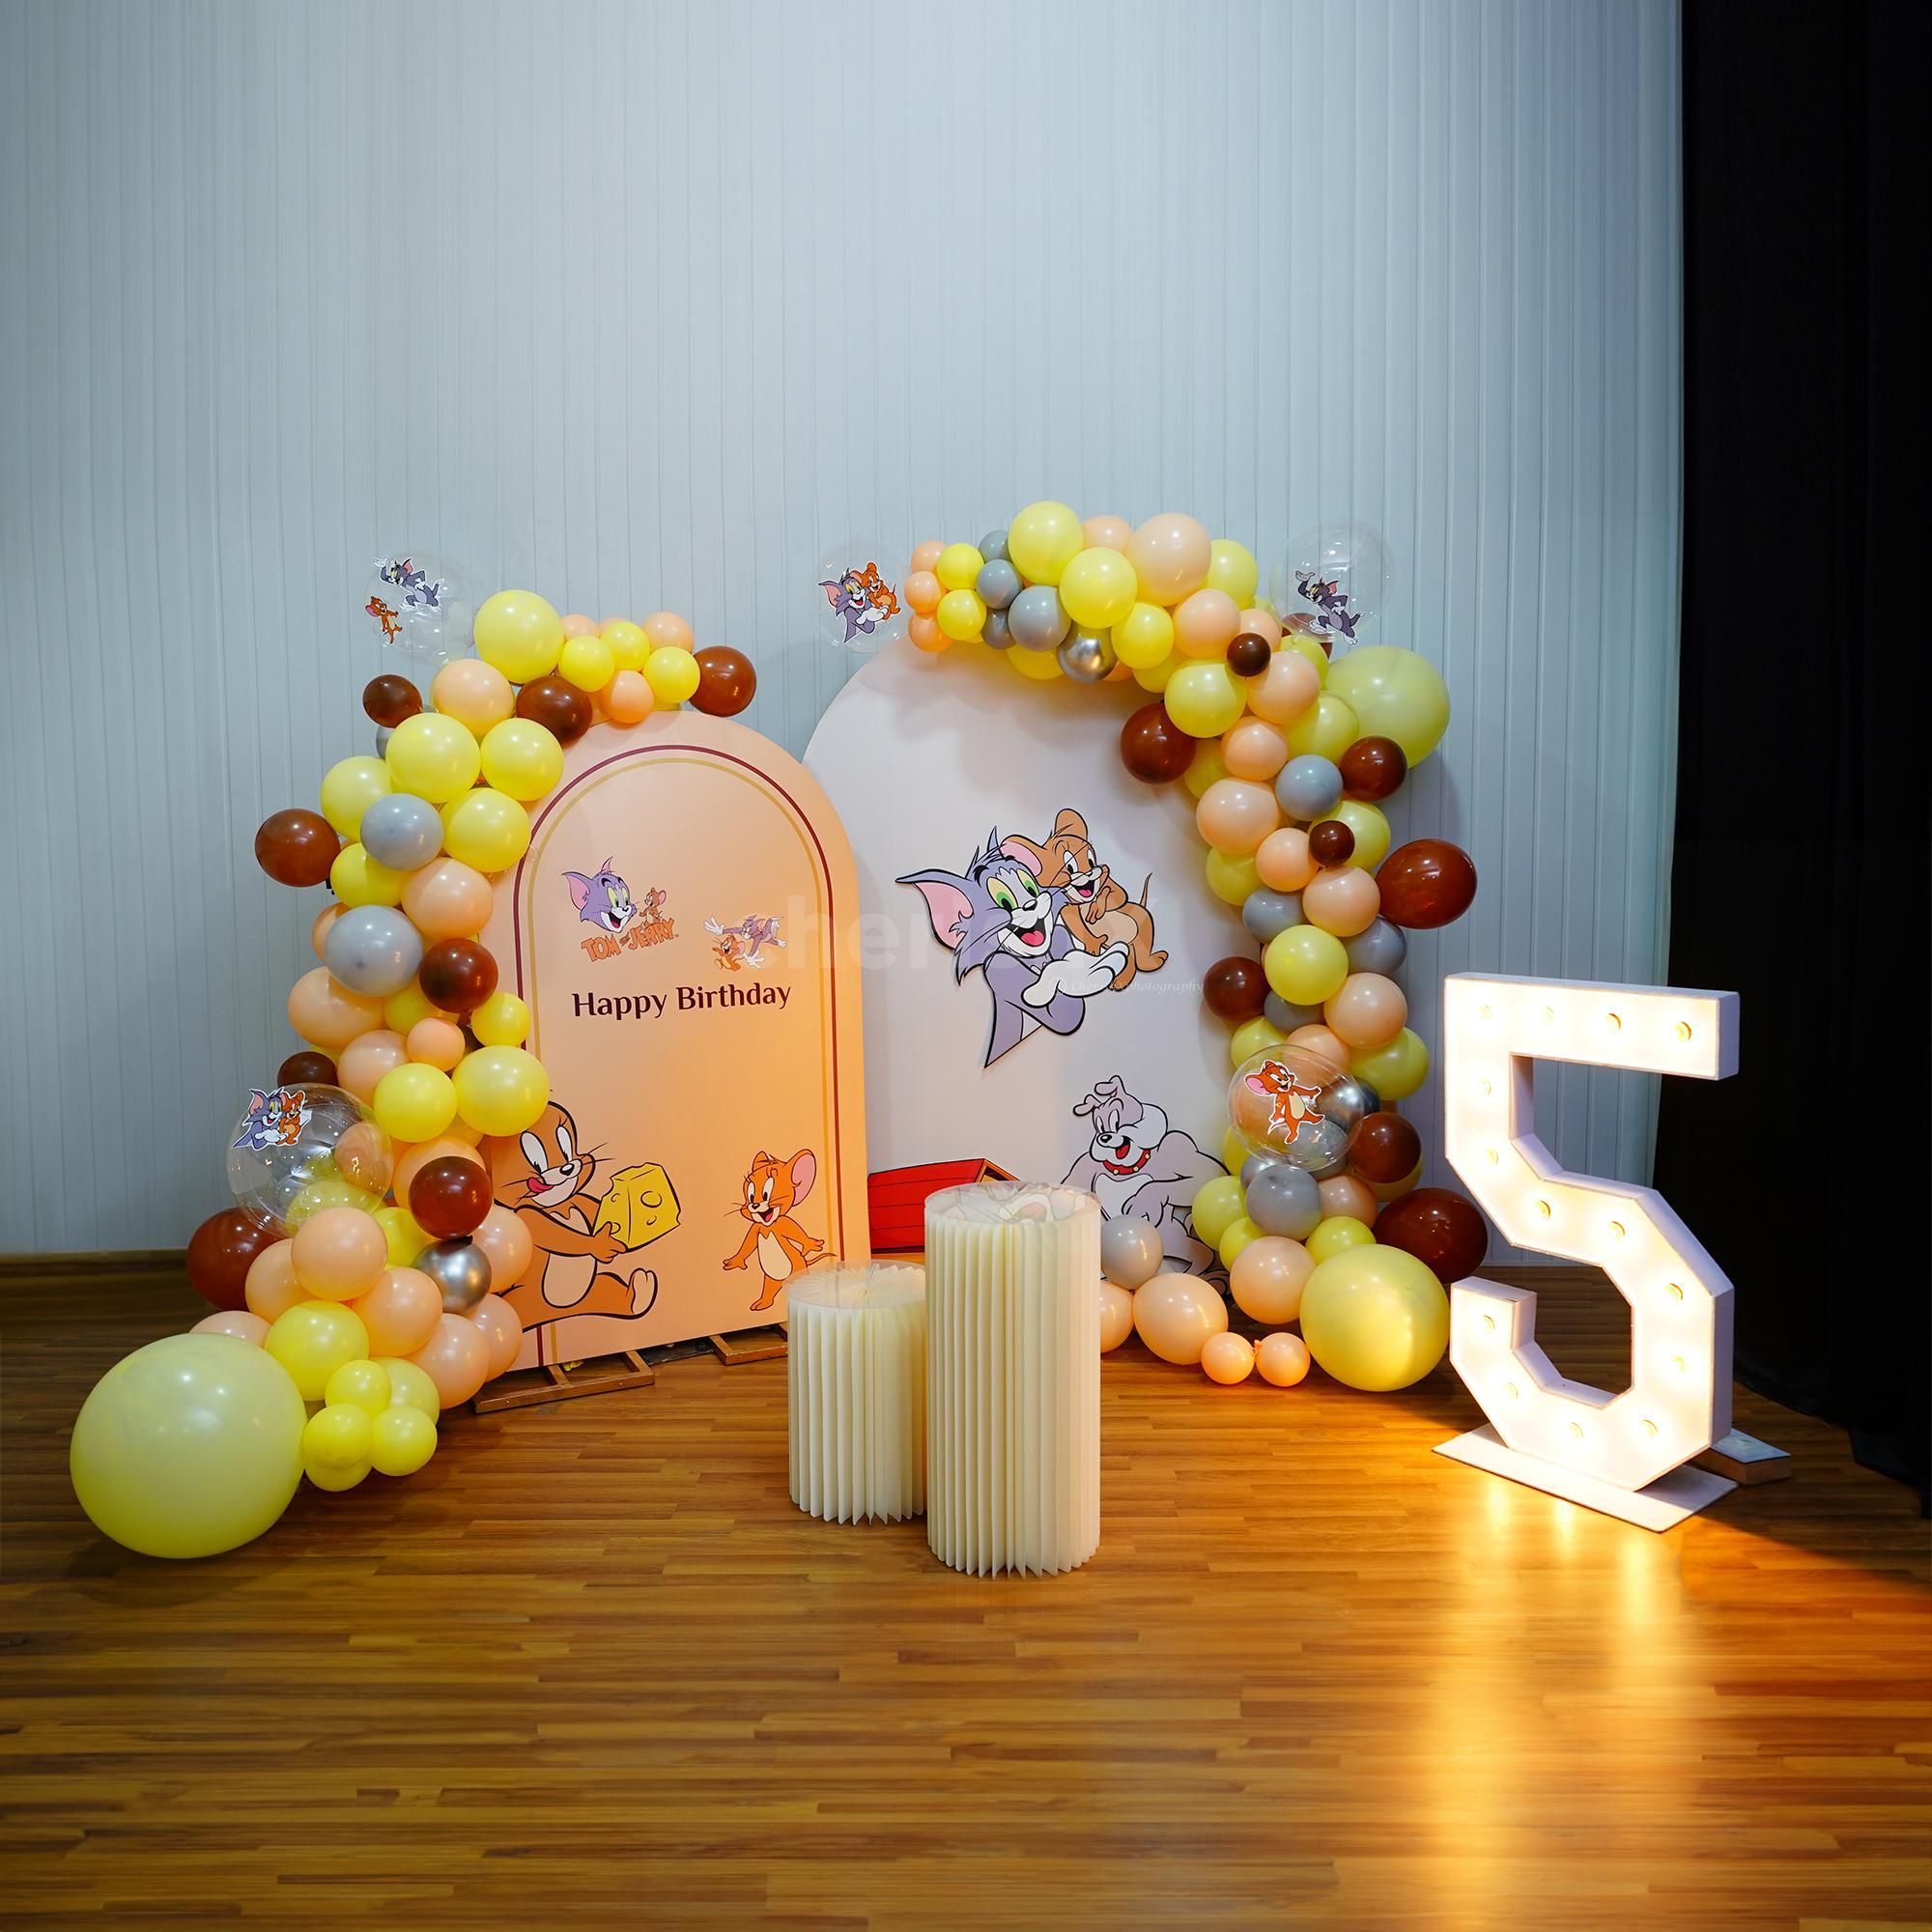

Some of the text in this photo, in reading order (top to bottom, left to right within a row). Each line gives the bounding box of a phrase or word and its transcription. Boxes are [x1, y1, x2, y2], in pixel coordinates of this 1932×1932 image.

[581, 933, 622, 962] TOM
[628, 917, 674, 951] JERRY
[572, 981, 791, 1021] Happy Birthday
[1444, 972, 1739, 1492] 5
